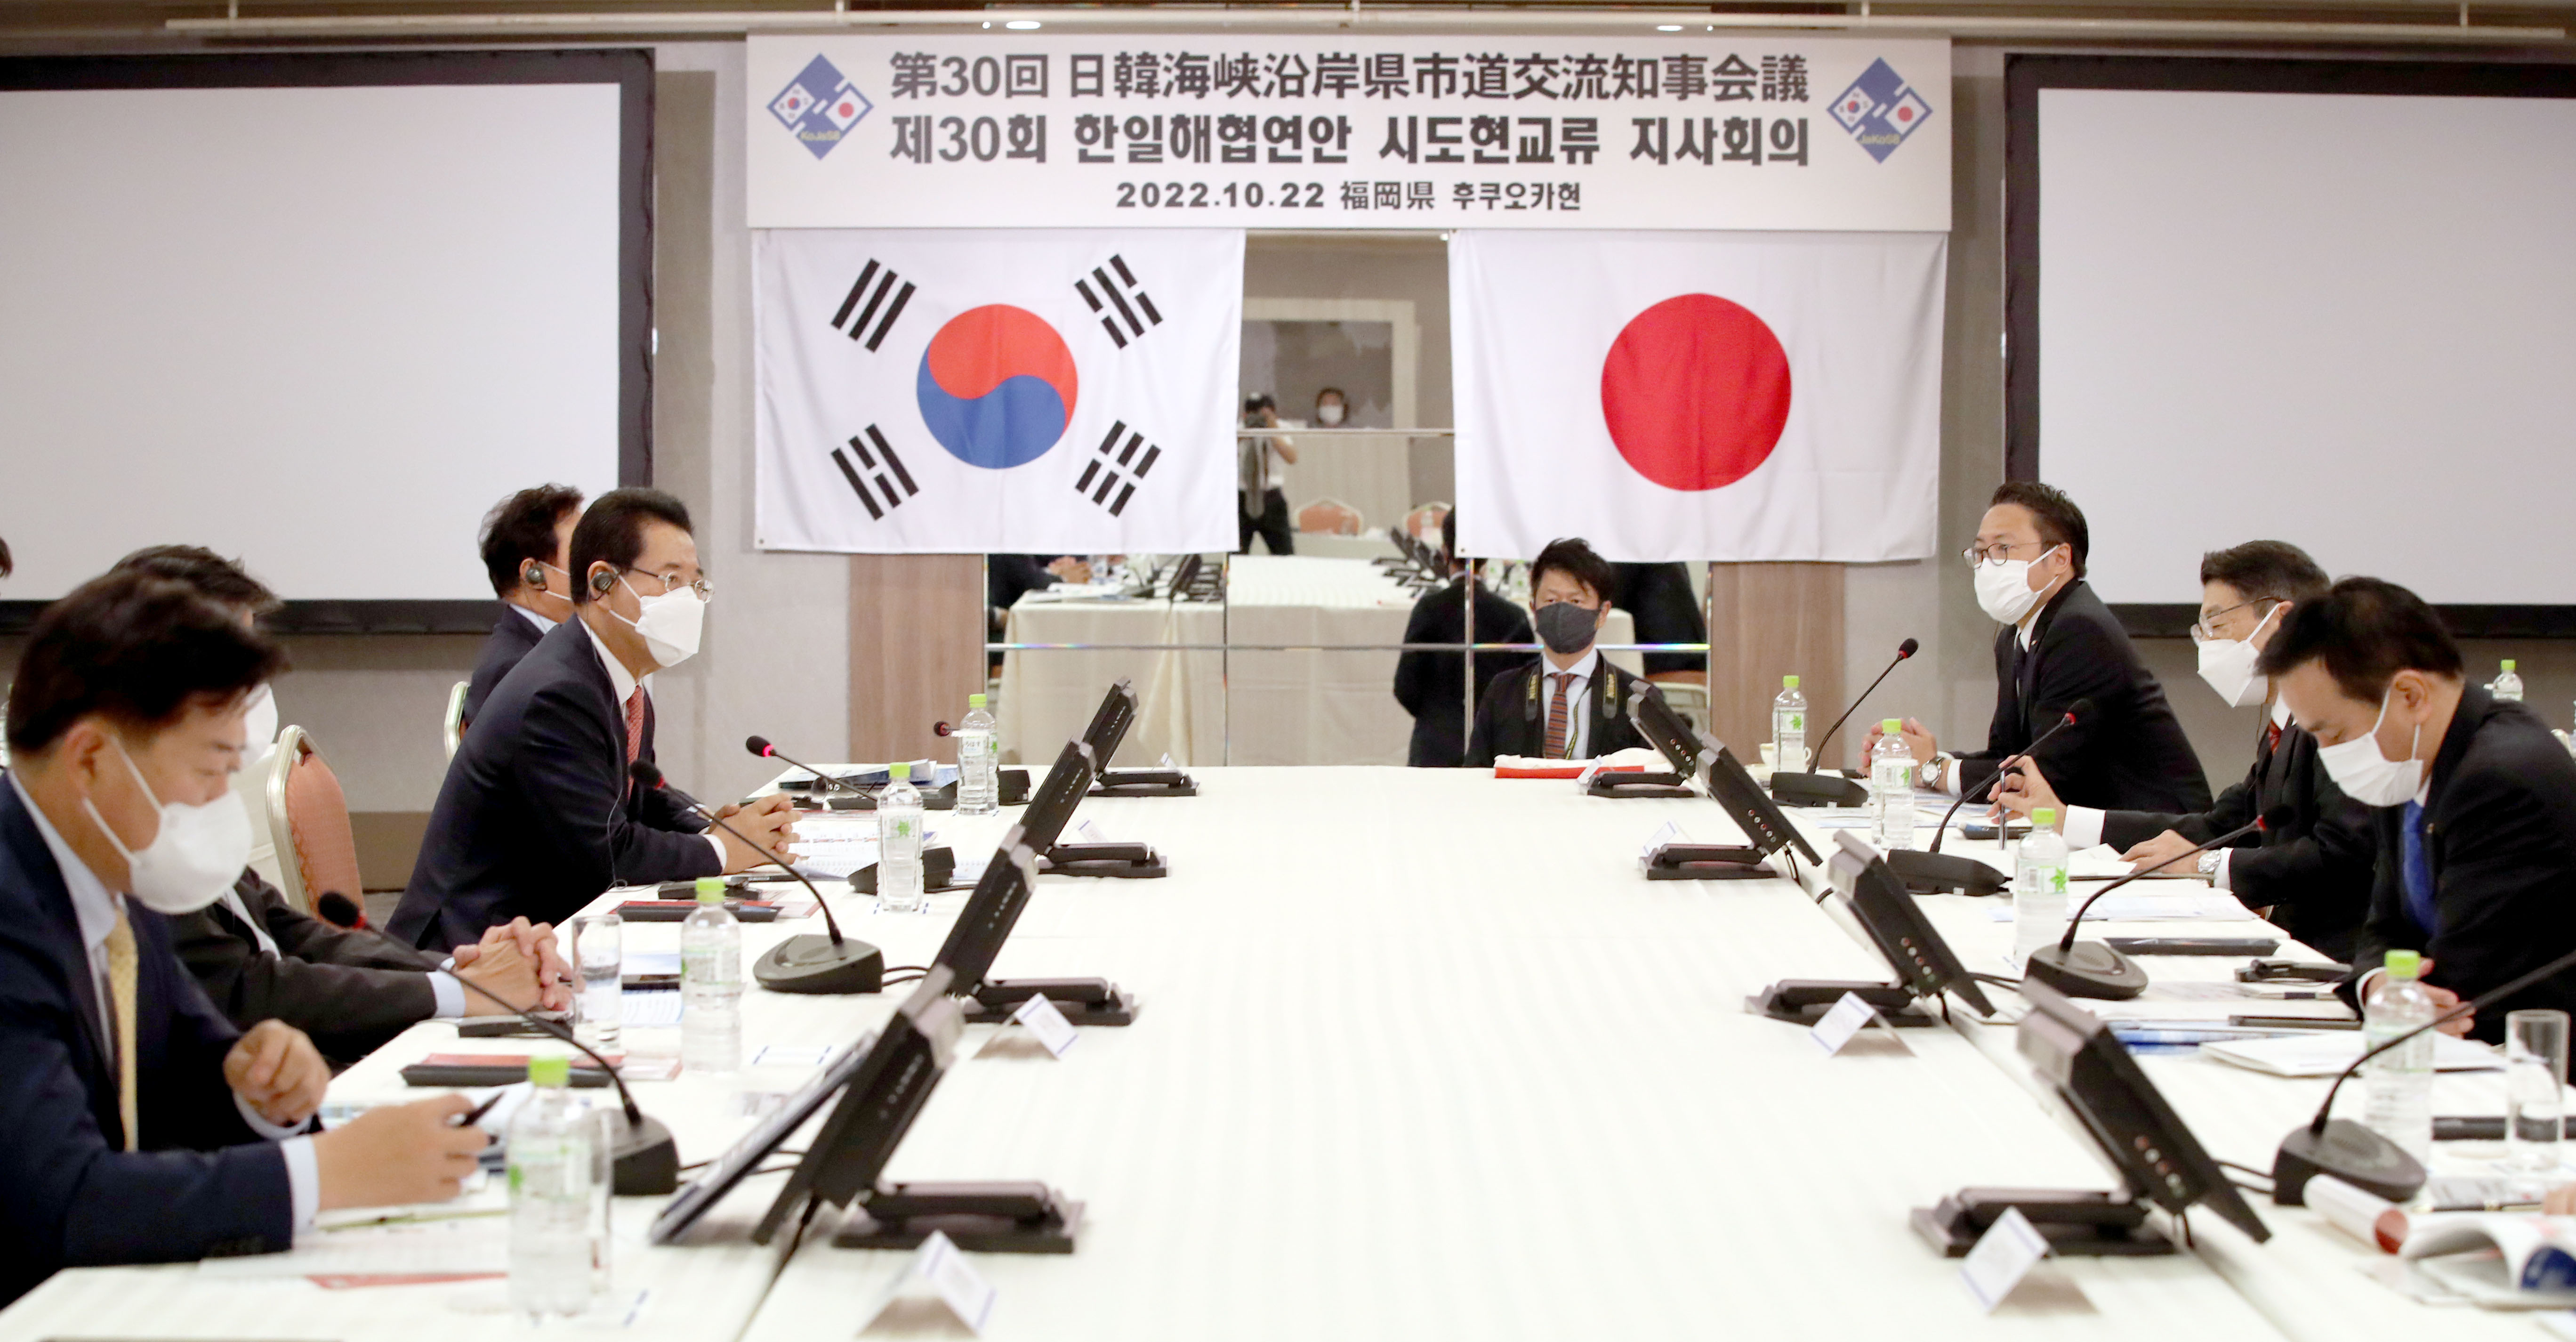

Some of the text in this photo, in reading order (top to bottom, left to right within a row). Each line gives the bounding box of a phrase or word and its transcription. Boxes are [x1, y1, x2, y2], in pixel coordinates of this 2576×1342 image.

[890, 51, 1810, 103] 第30回 日韓海峡沿岸県市道交流知事会議
[891, 114, 1809, 166] 제30회 한일해협연안 시도현교류 지사회의
[1117, 181, 1581, 210] 2022.10.22 福岡県 후쿠오카현
